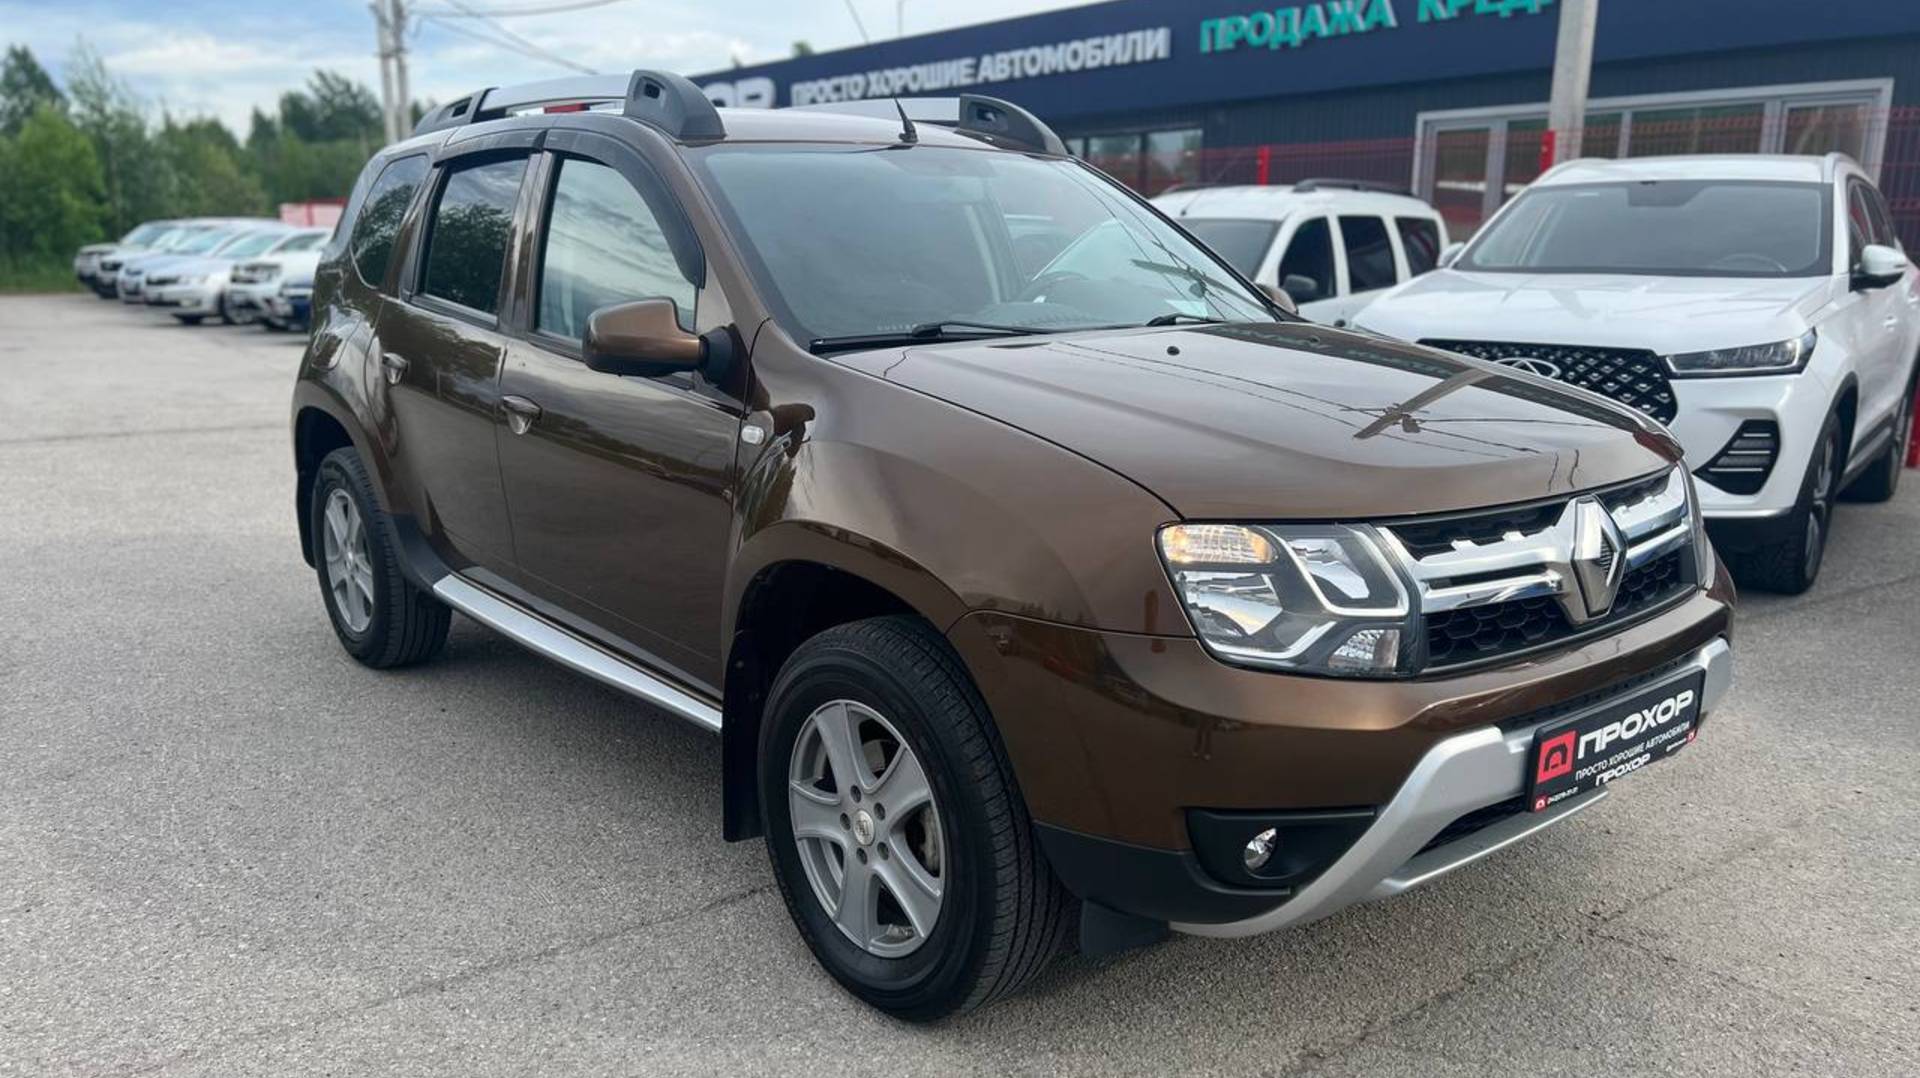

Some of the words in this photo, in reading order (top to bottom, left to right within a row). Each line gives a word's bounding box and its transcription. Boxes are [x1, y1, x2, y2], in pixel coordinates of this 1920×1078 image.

[1200, 0, 1397, 52] ПРОДАЖА
[790, 73, 867, 107] ПРОСТО
[866, 57, 977, 98] ХОРОШИЕ
[978, 27, 1171, 82] АВТОМОБИЛИ
[1575, 759, 1609, 781] ПРОСТО
[1608, 742, 1645, 766] ХОРОШИЕ
[1644, 720, 1690, 750] АВТОМОБИЛИ
[1577, 690, 1694, 759] ПРОХОР
[1595, 753, 1651, 786] ПРОХОР
